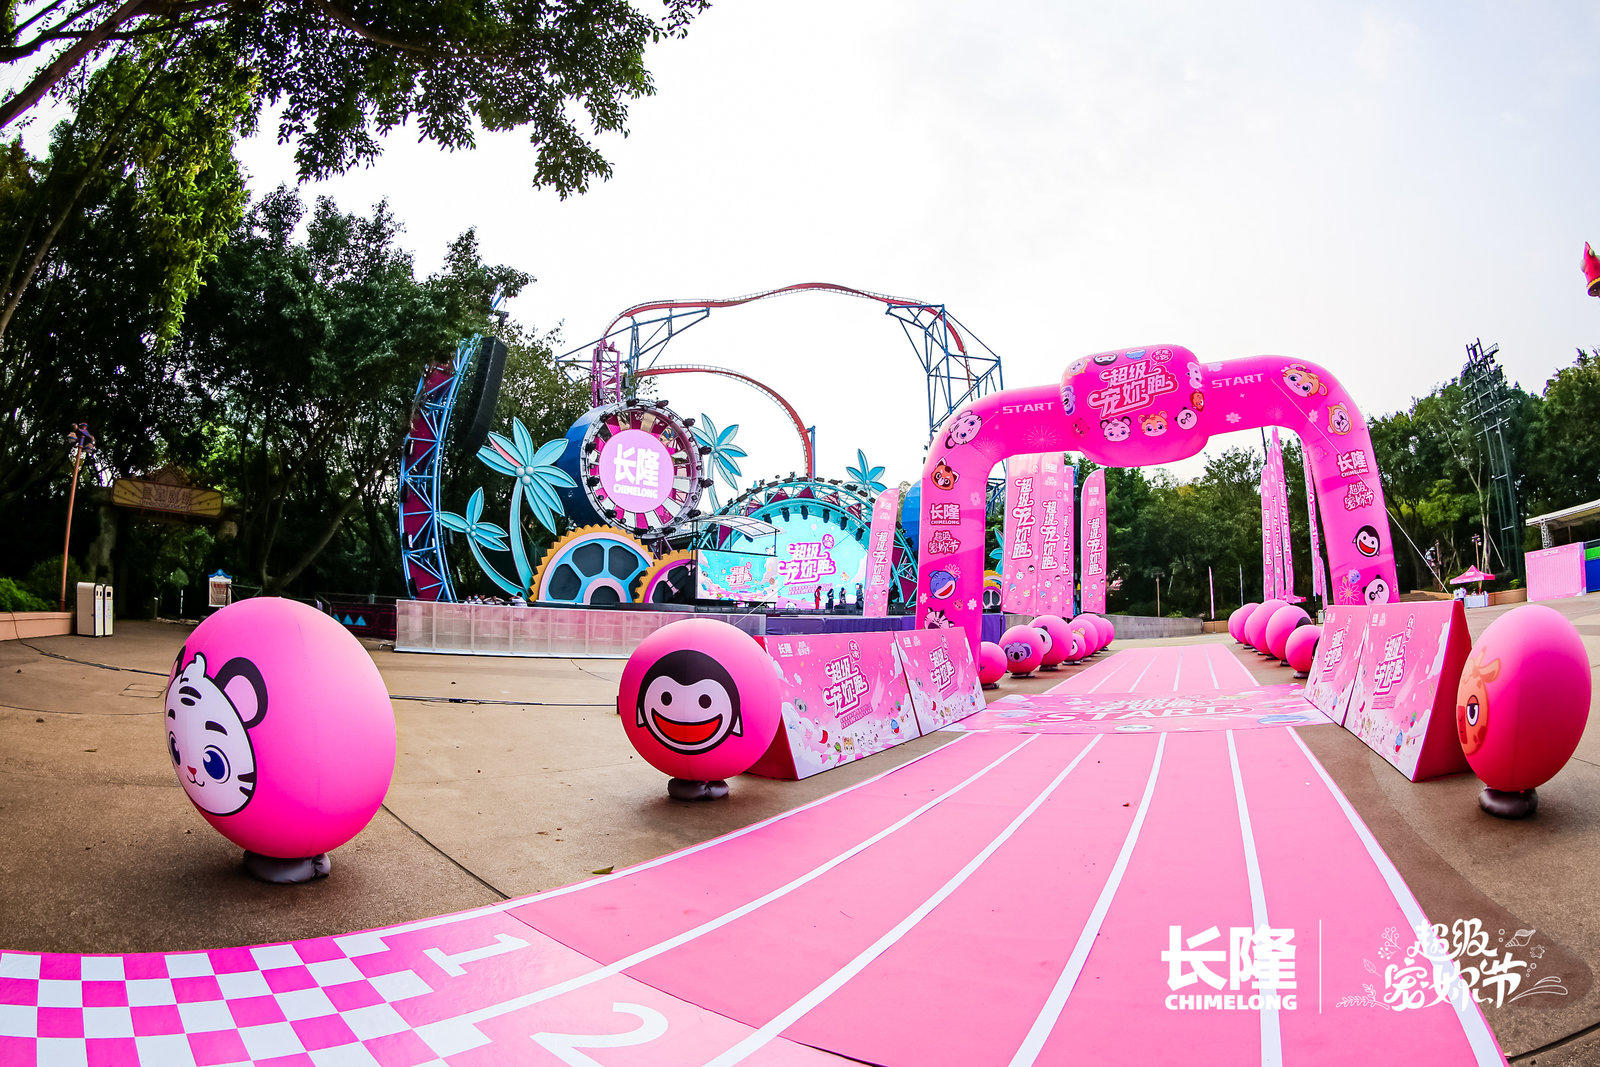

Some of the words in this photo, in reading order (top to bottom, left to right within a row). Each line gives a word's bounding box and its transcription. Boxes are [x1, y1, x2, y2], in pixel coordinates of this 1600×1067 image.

[1100, 360, 1162, 387] 超级
[1211, 373, 1264, 388] START
[1003, 402, 1054, 414] START
[613, 443, 660, 487] 长隆
[1337, 450, 1367, 472] 长隆
[613, 484, 659, 499] CHIMELONG
[930, 504, 960, 520] 长隆
[825, 655, 859, 683] 超级
[1038, 706, 1254, 721] START
[422, 932, 531, 978] 1
[529, 1002, 669, 1067] 2
